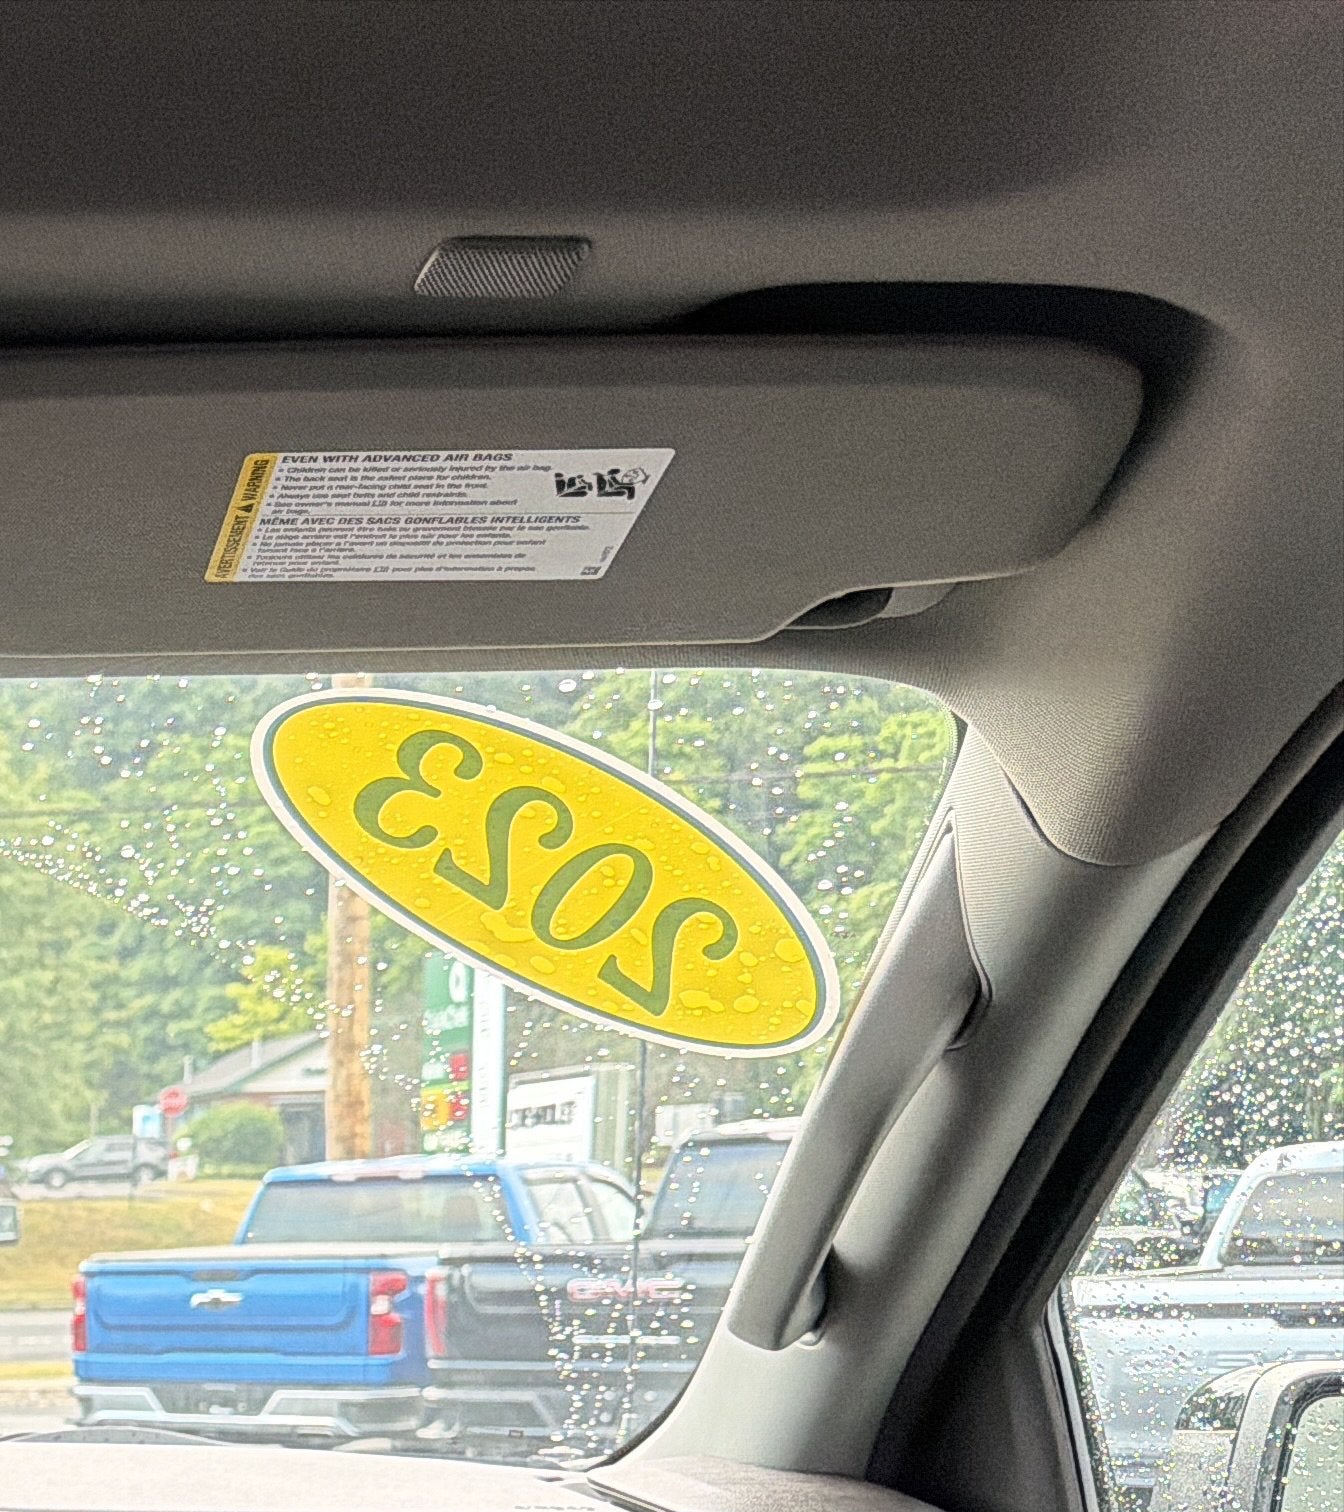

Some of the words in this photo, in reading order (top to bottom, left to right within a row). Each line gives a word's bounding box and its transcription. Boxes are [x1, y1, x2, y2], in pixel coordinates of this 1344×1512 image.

[282, 455, 318, 463] EVEN
[323, 454, 358, 463] WITH
[362, 454, 440, 462] ADVANCED
[443, 453, 469, 462] AIR
[472, 453, 513, 461] BAGS
[242, 460, 269, 502] WARNING
[260, 516, 298, 525] MÊME
[300, 517, 335, 525] AVEC
[338, 517, 363, 525] DES
[366, 516, 401, 524] SACS
[404, 516, 488, 524] GONFLABLES
[491, 516, 581, 524] INTELLIGENTS
[215, 514, 249, 578] AVERTISSEMENT
[567, 1278, 685, 1302] GMC
